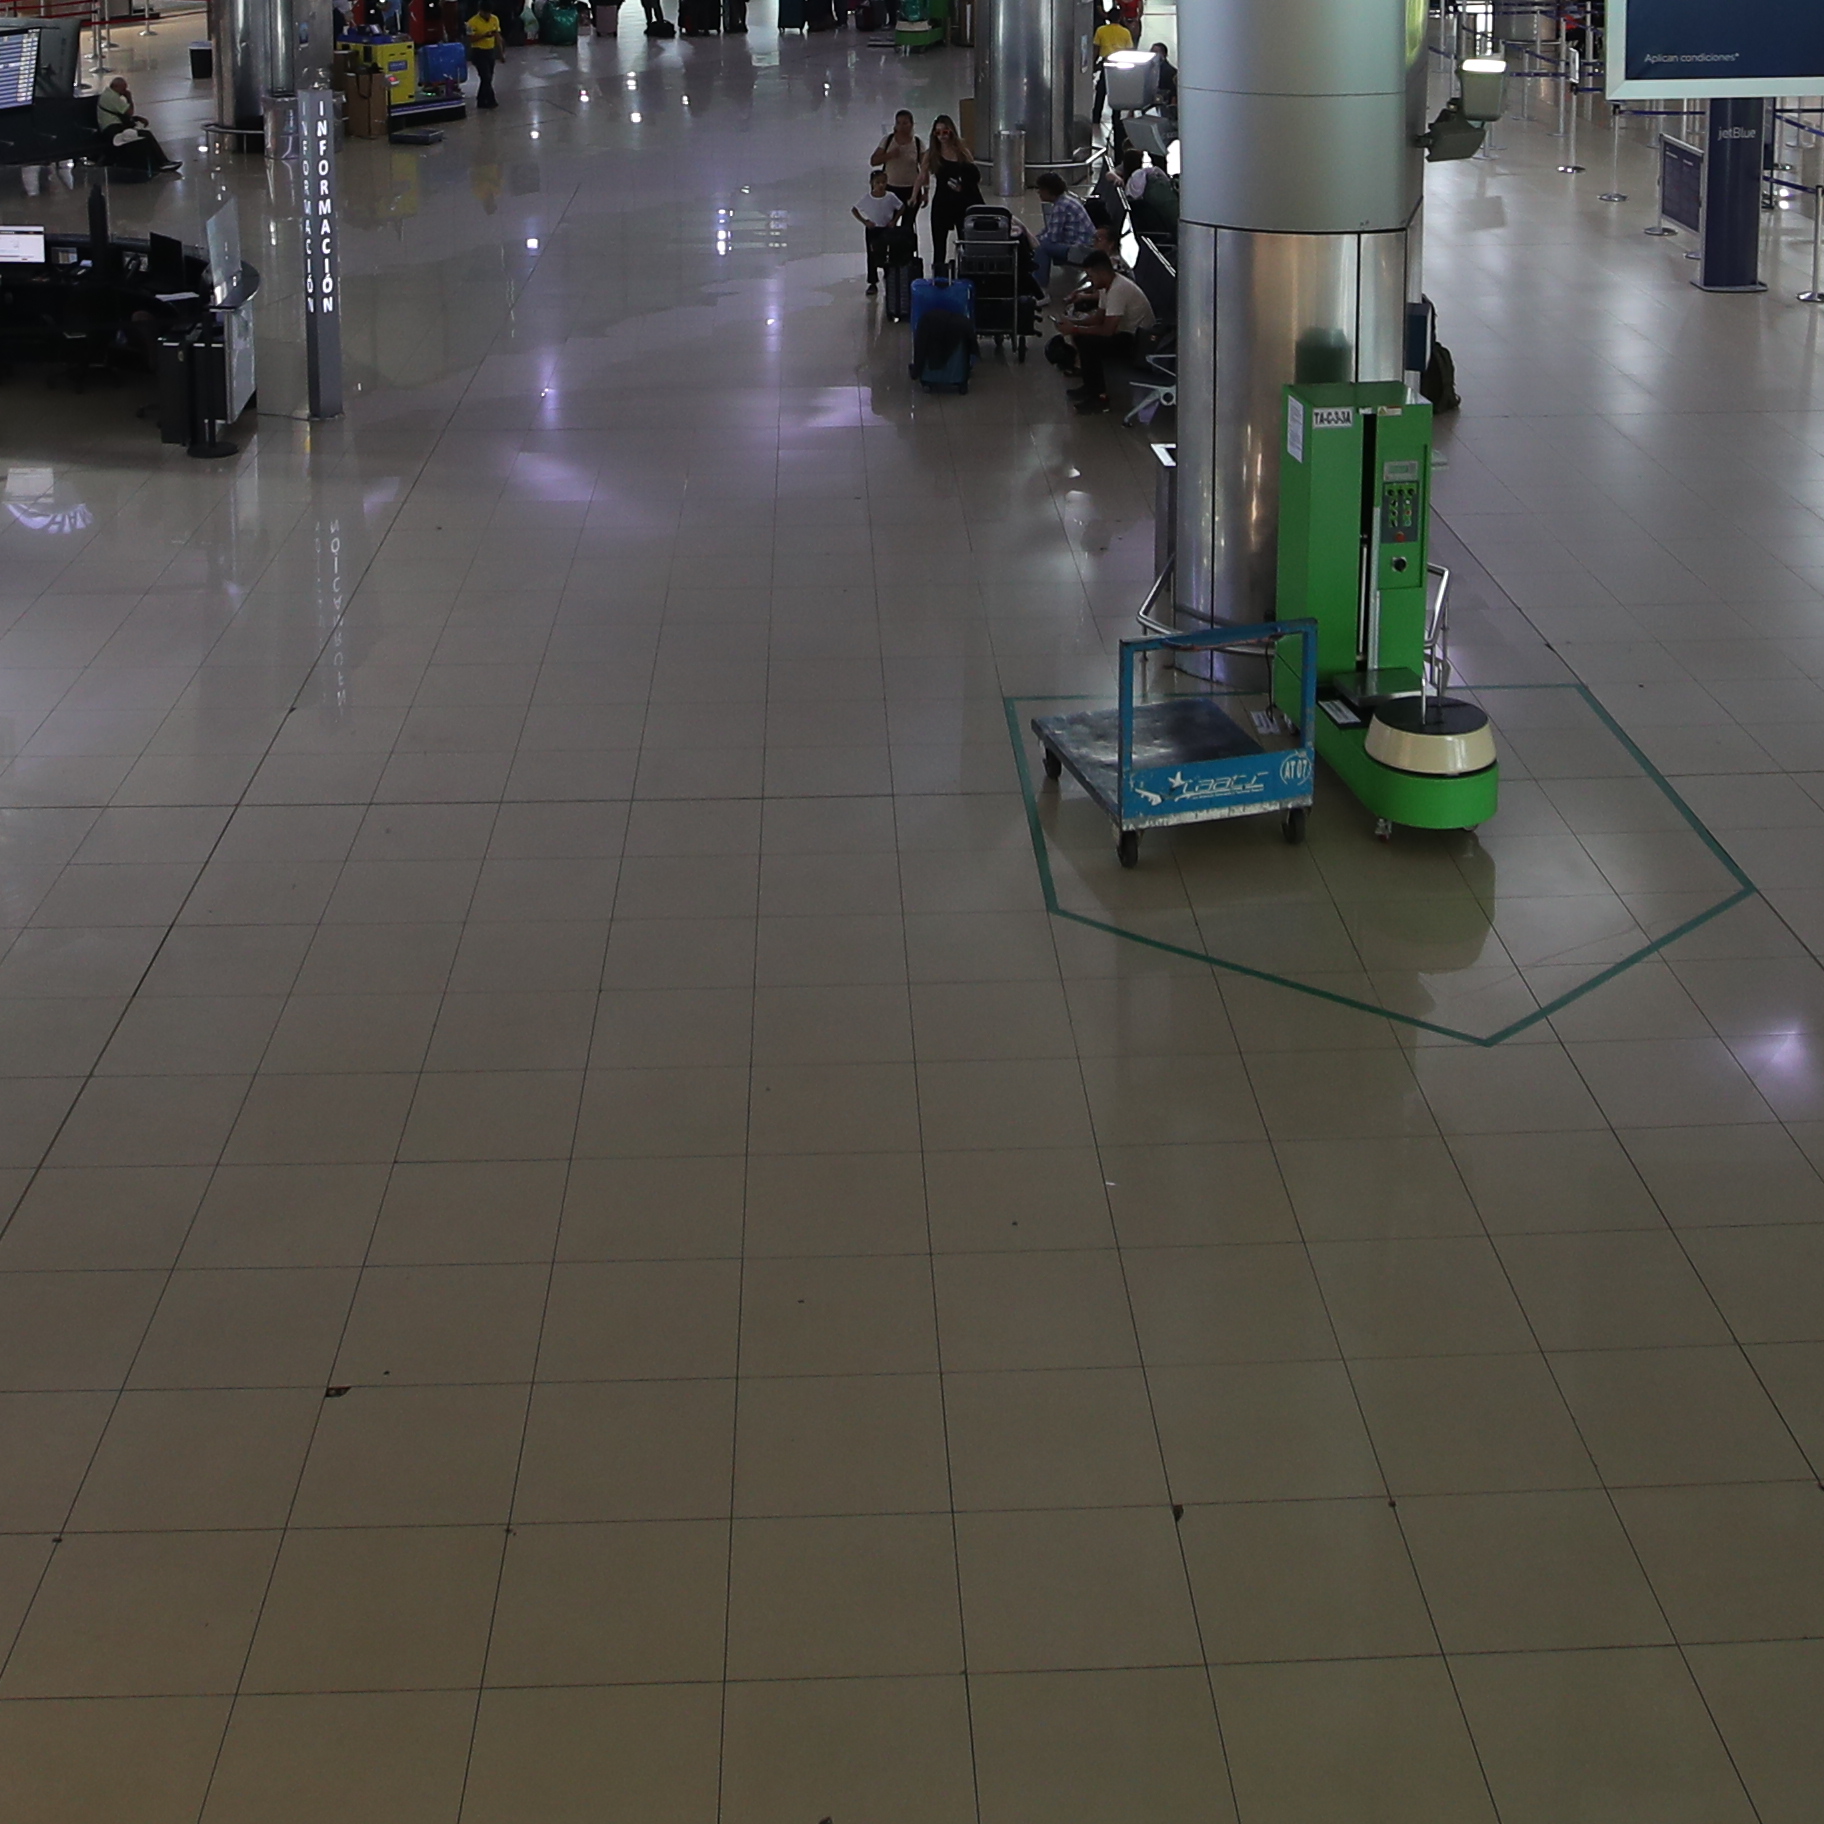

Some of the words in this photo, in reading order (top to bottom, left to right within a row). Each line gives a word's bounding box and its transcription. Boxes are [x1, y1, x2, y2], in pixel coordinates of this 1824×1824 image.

[1644, 53, 1679, 65] Aplican
[1717, 127, 1756, 141] jetBlue
[316, 100, 334, 313] INFORMACIÓN
